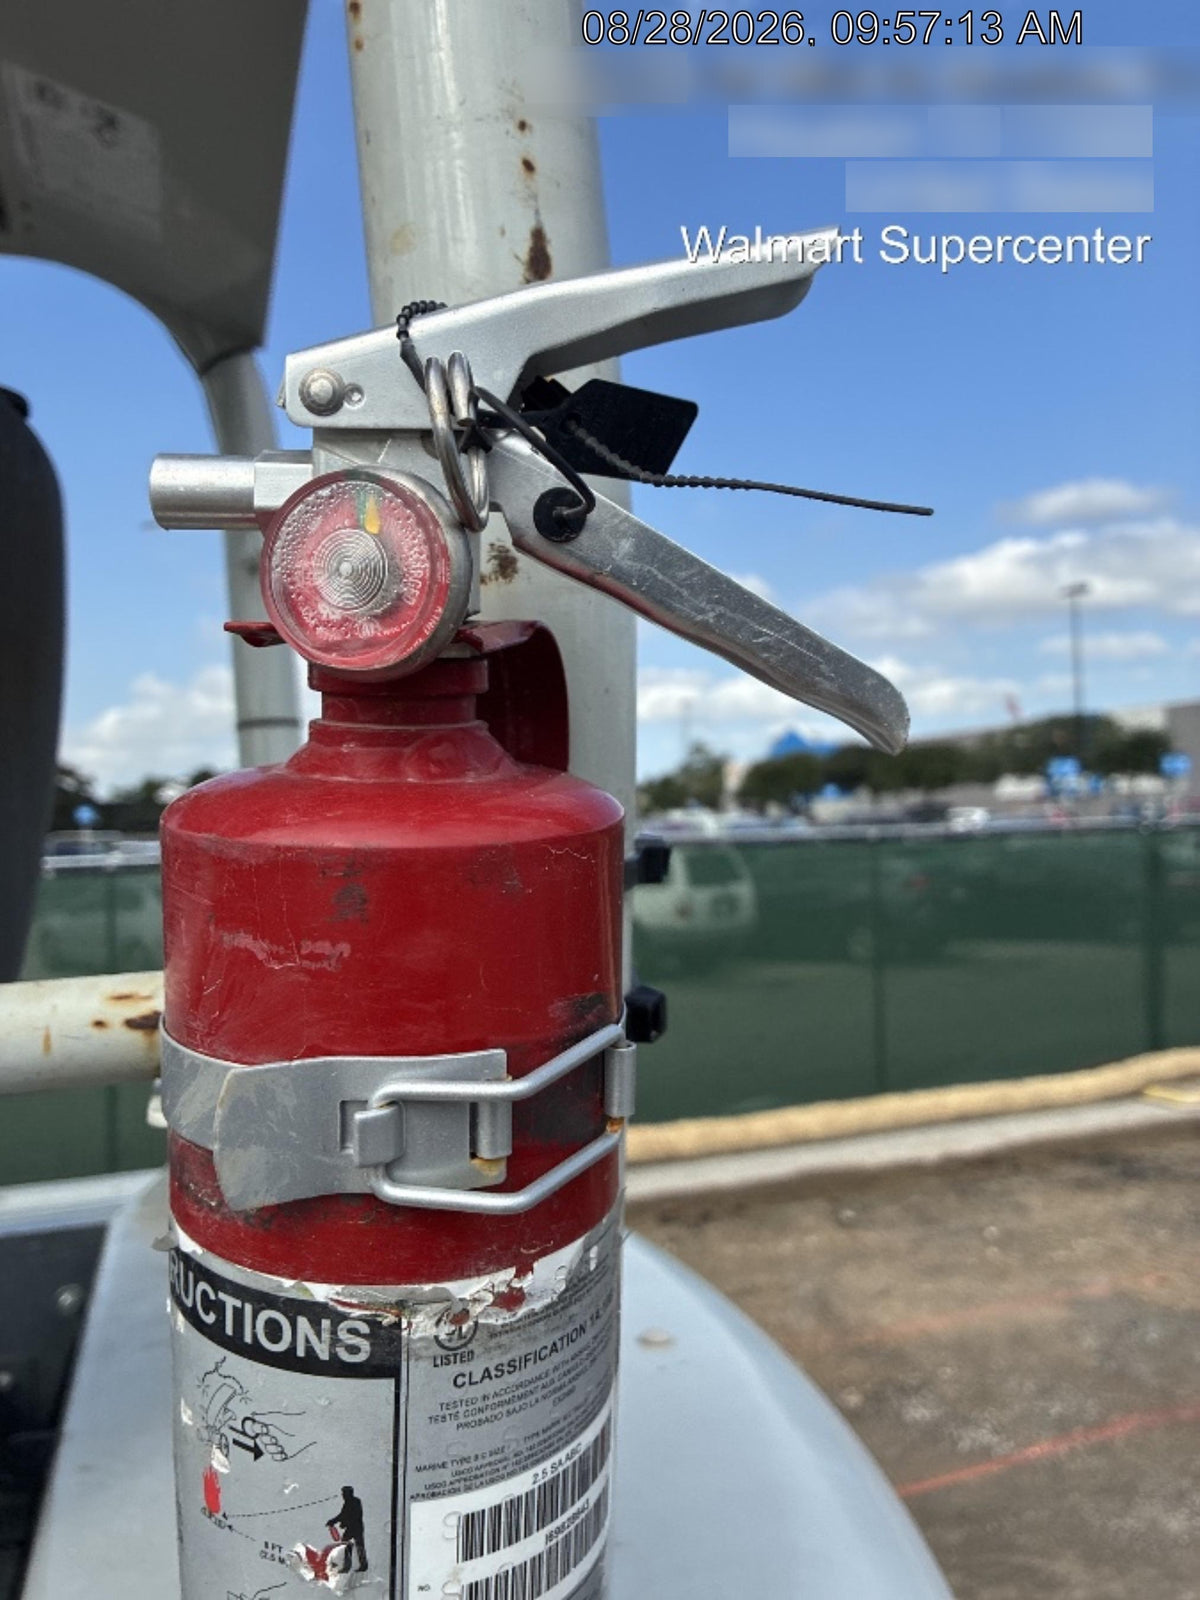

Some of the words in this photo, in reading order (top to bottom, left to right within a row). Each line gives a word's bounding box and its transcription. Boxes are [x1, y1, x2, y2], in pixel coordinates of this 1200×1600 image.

[433, 1350, 474, 1368] LISTED
[453, 1324, 586, 1389] CLASSIFICATION
[439, 1397, 479, 1412] TESTED
[415, 1461, 449, 1473] MARINE
[451, 1457, 471, 1467] TYPE
[271, 1543, 283, 1553] FT
